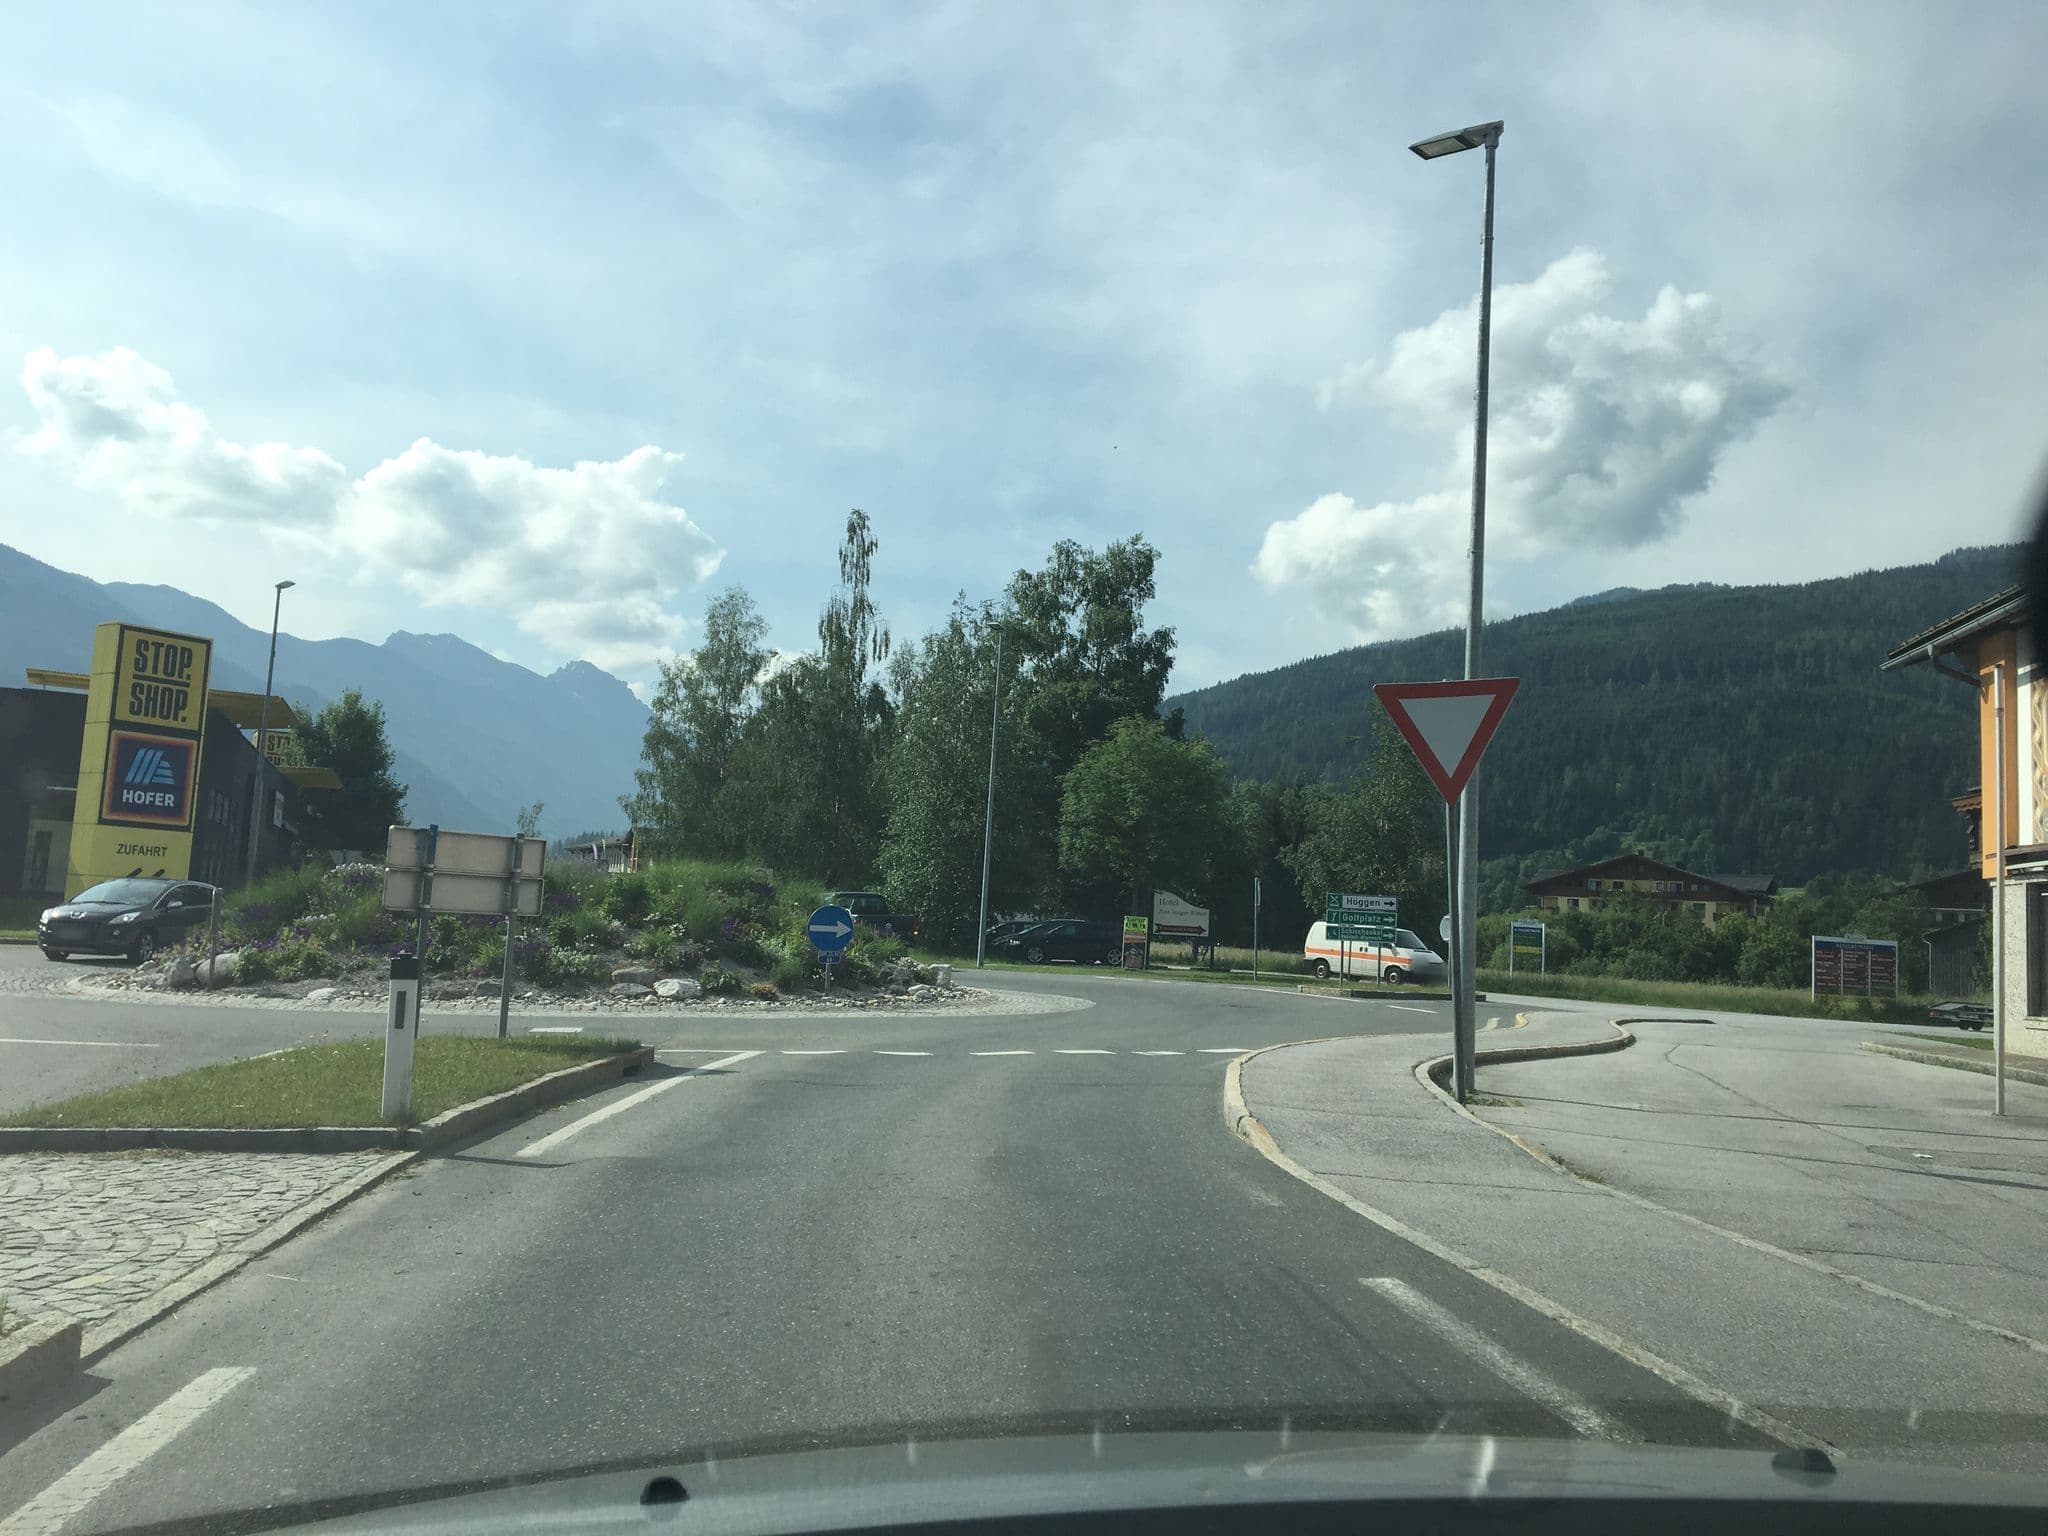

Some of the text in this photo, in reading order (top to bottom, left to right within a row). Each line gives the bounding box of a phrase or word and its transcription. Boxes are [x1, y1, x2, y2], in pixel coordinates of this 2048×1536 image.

[134, 639, 193, 681] STOP.
[129, 682, 189, 723] SHOP.
[122, 789, 175, 807] HOFER
[116, 843, 168, 857] ZUFAHRT
[1346, 897, 1381, 907] Höggen
[1342, 913, 1381, 923] Golfplatz
